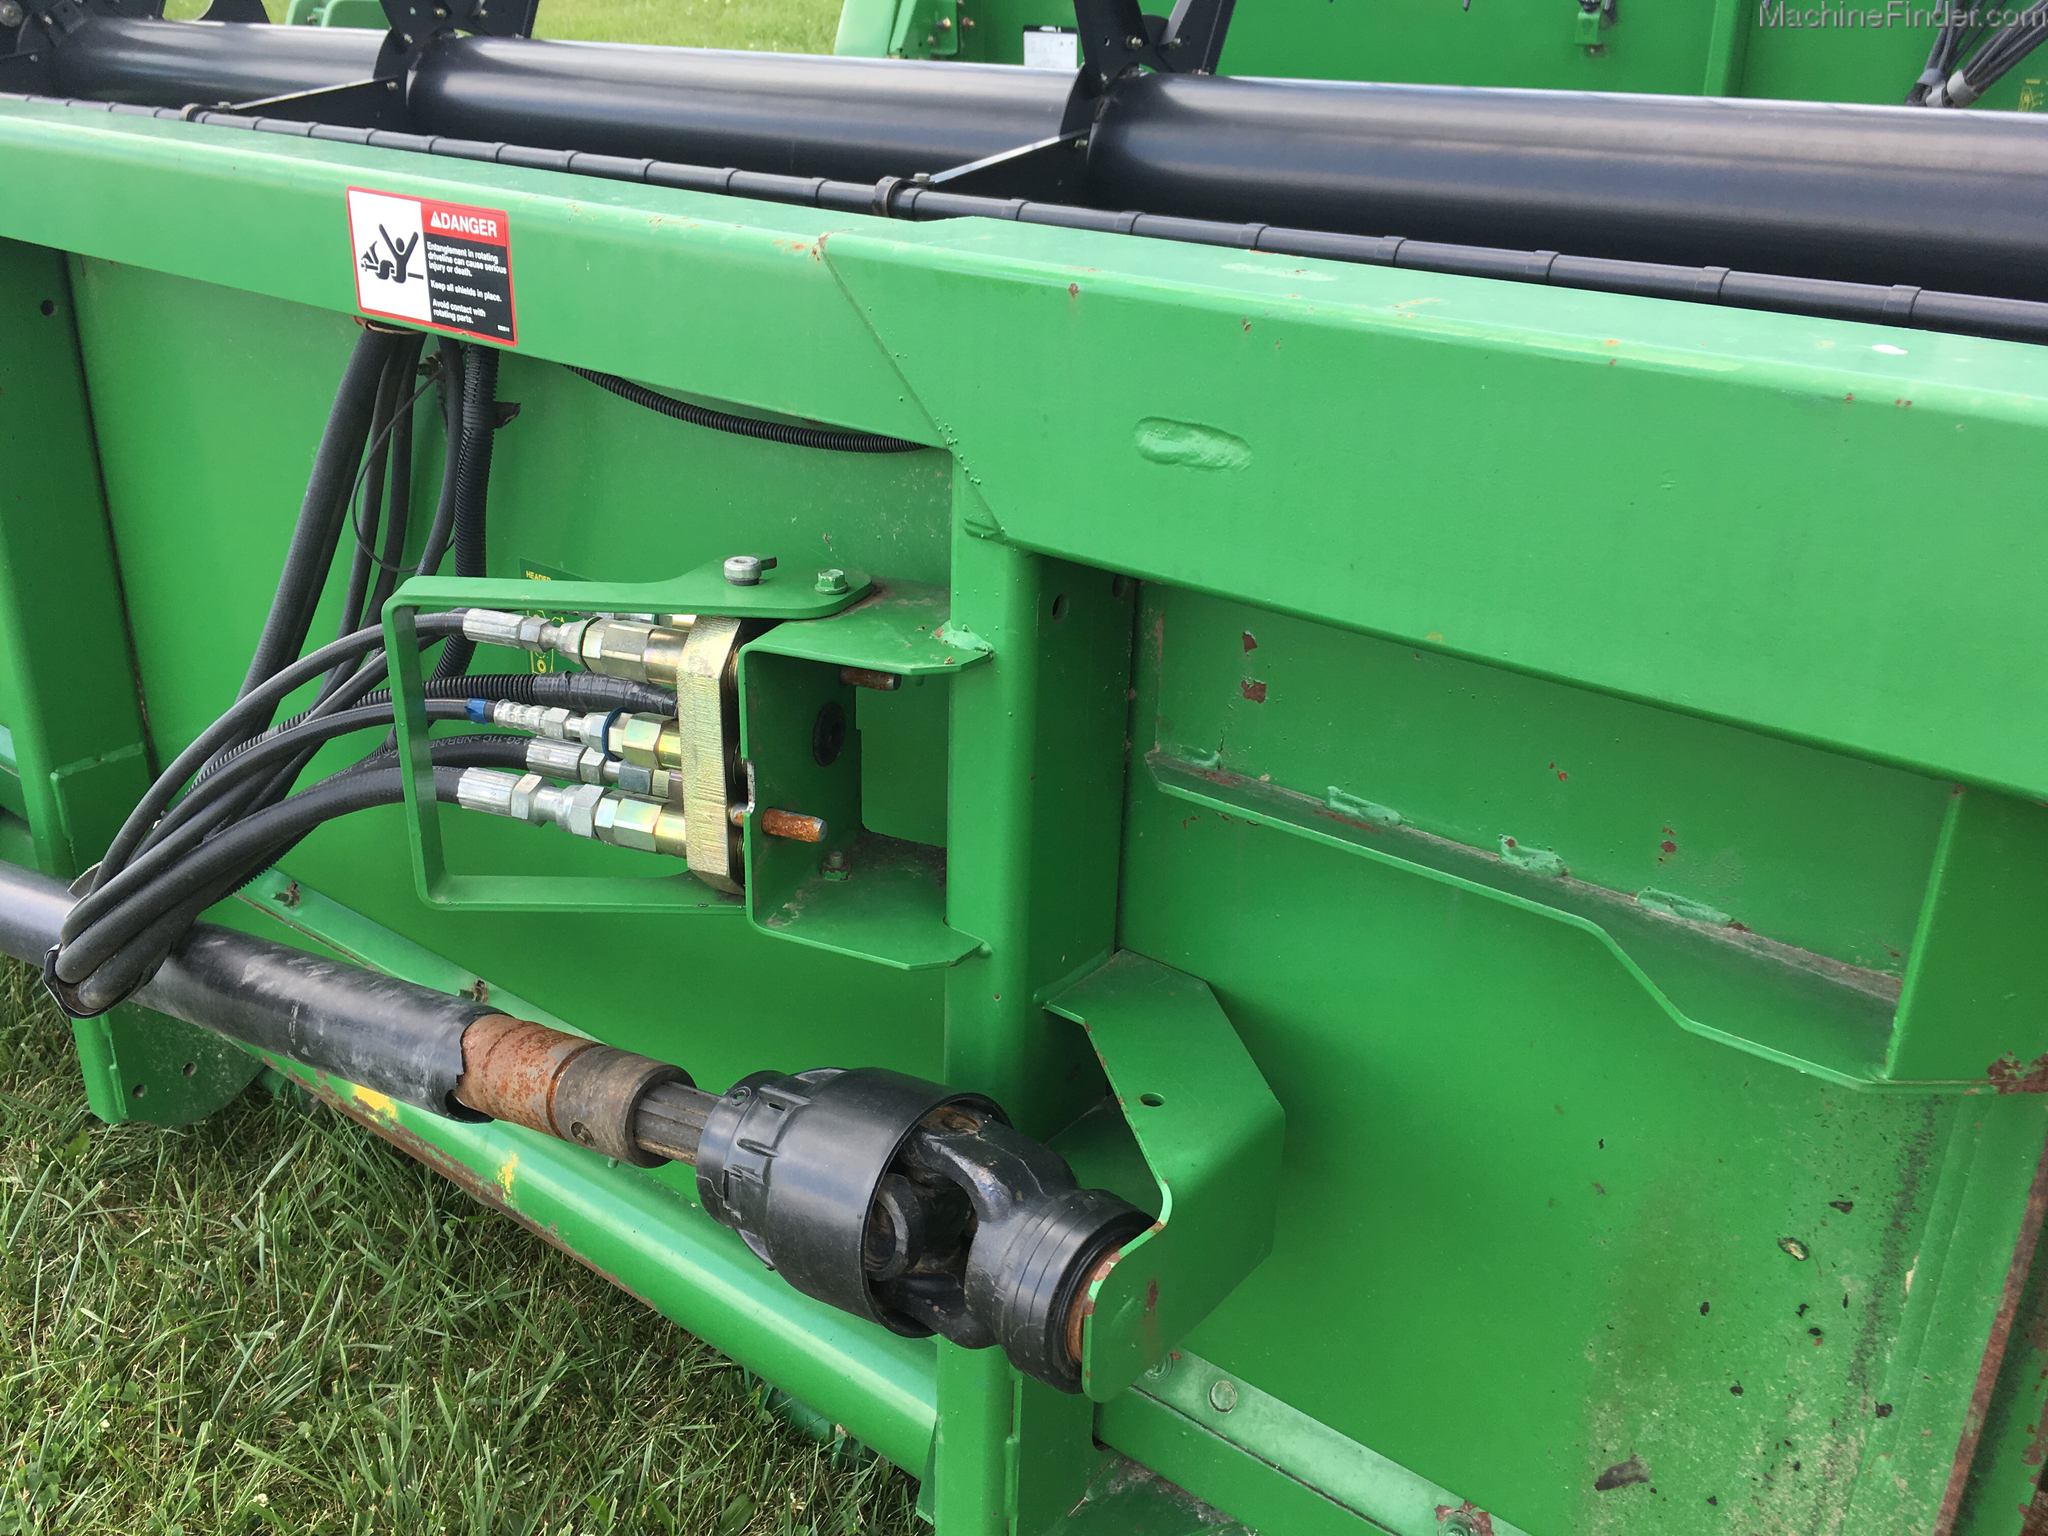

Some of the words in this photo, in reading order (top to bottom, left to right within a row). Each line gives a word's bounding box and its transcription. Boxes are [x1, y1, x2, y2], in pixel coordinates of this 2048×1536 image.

[440, 212, 498, 238] DANGER
[427, 241, 467, 257] Entanglement
[467, 249, 474, 258] in
[475, 251, 498, 265] rotating
[428, 252, 453, 264] driveline
[454, 257, 465, 266] can
[466, 260, 483, 270] cause
[485, 263, 507, 275] serious
[428, 261, 445, 274] injury
[446, 265, 453, 273] or
[454, 266, 473, 277] death.
[430, 279, 446, 291] Keep
[446, 283, 454, 292] all
[455, 285, 476, 297] shields
[477, 288, 483, 298] in
[484, 291, 502, 302] place.
[432, 298, 449, 310] Avoid
[450, 303, 472, 314] contact
[473, 307, 486, 317] with
[433, 309, 456, 322] rotating
[457, 313, 474, 324] parts.
